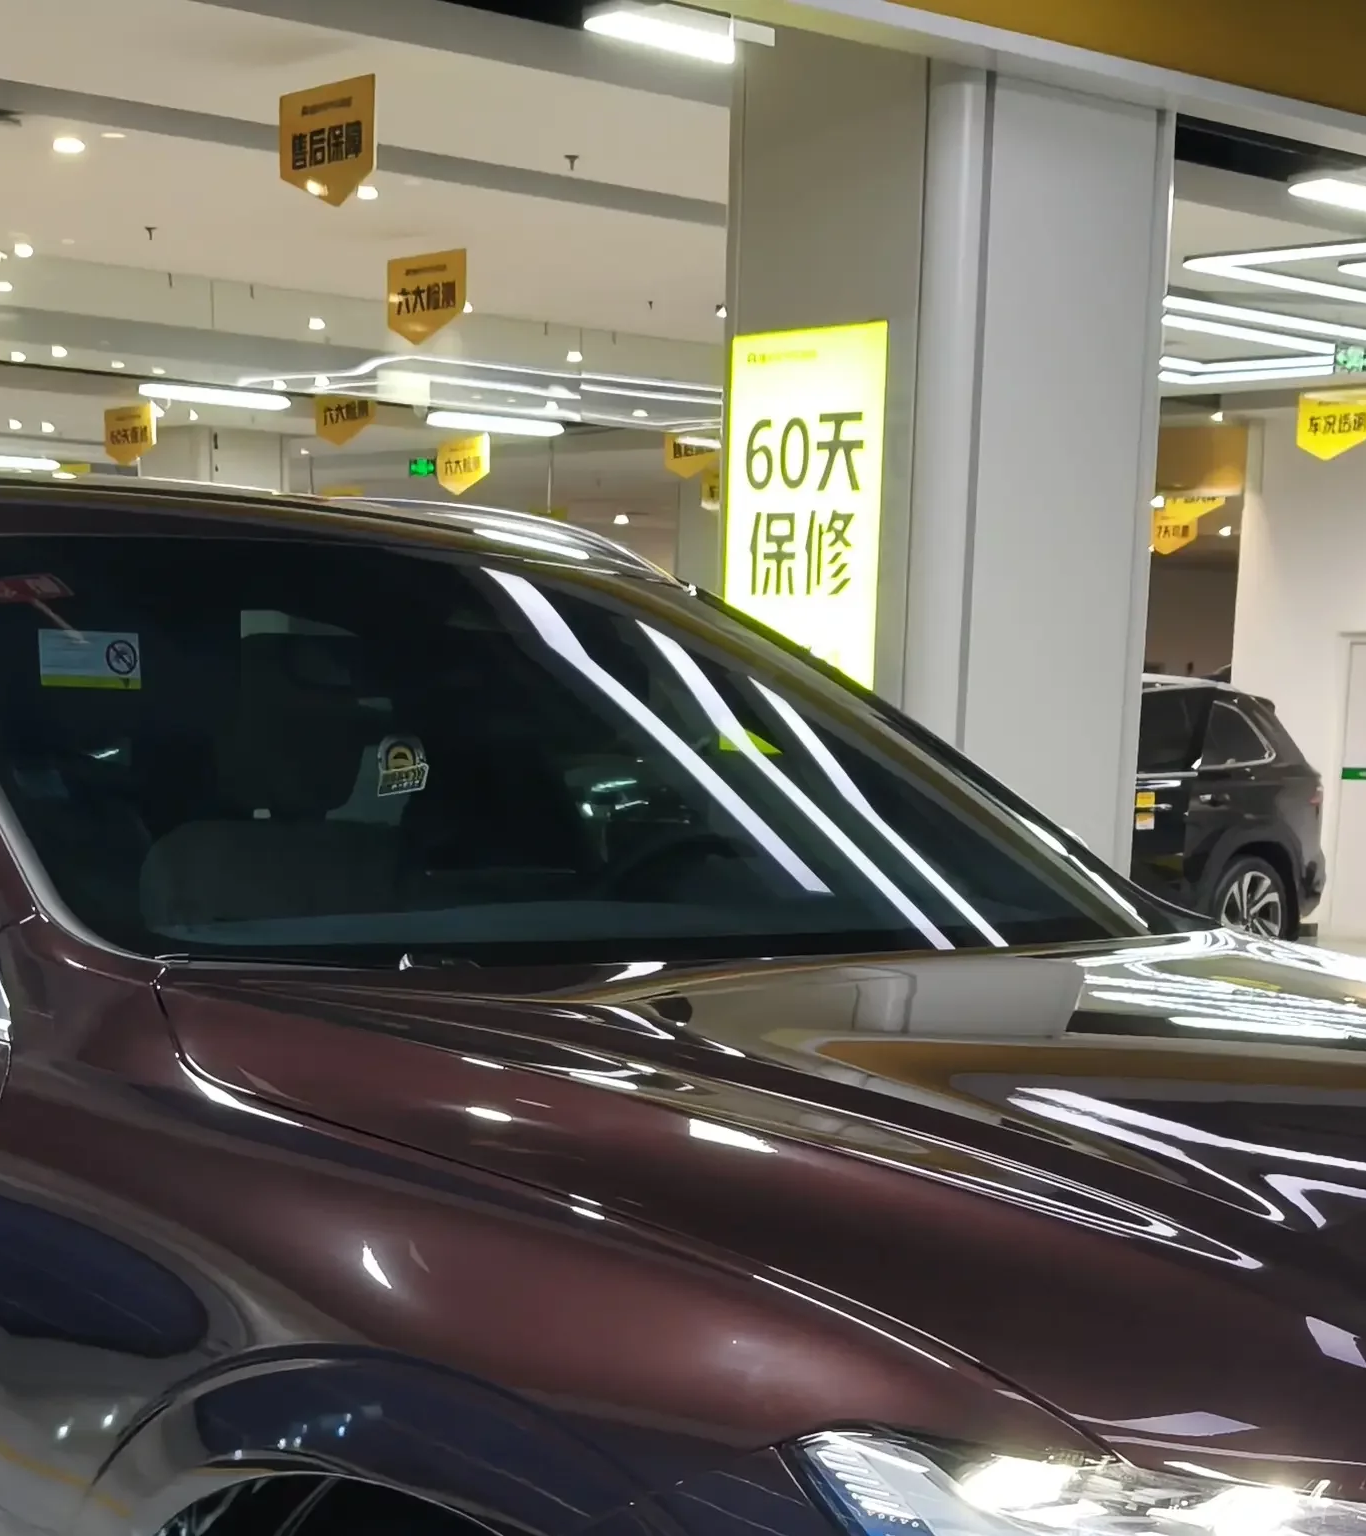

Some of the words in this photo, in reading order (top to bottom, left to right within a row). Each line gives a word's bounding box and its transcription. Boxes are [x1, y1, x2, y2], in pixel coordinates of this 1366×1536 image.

[292, 120, 362, 170] 售后保障
[396, 281, 456, 316] 六大检测
[745, 411, 864, 491] 60天
[749, 510, 855, 595] 保修
